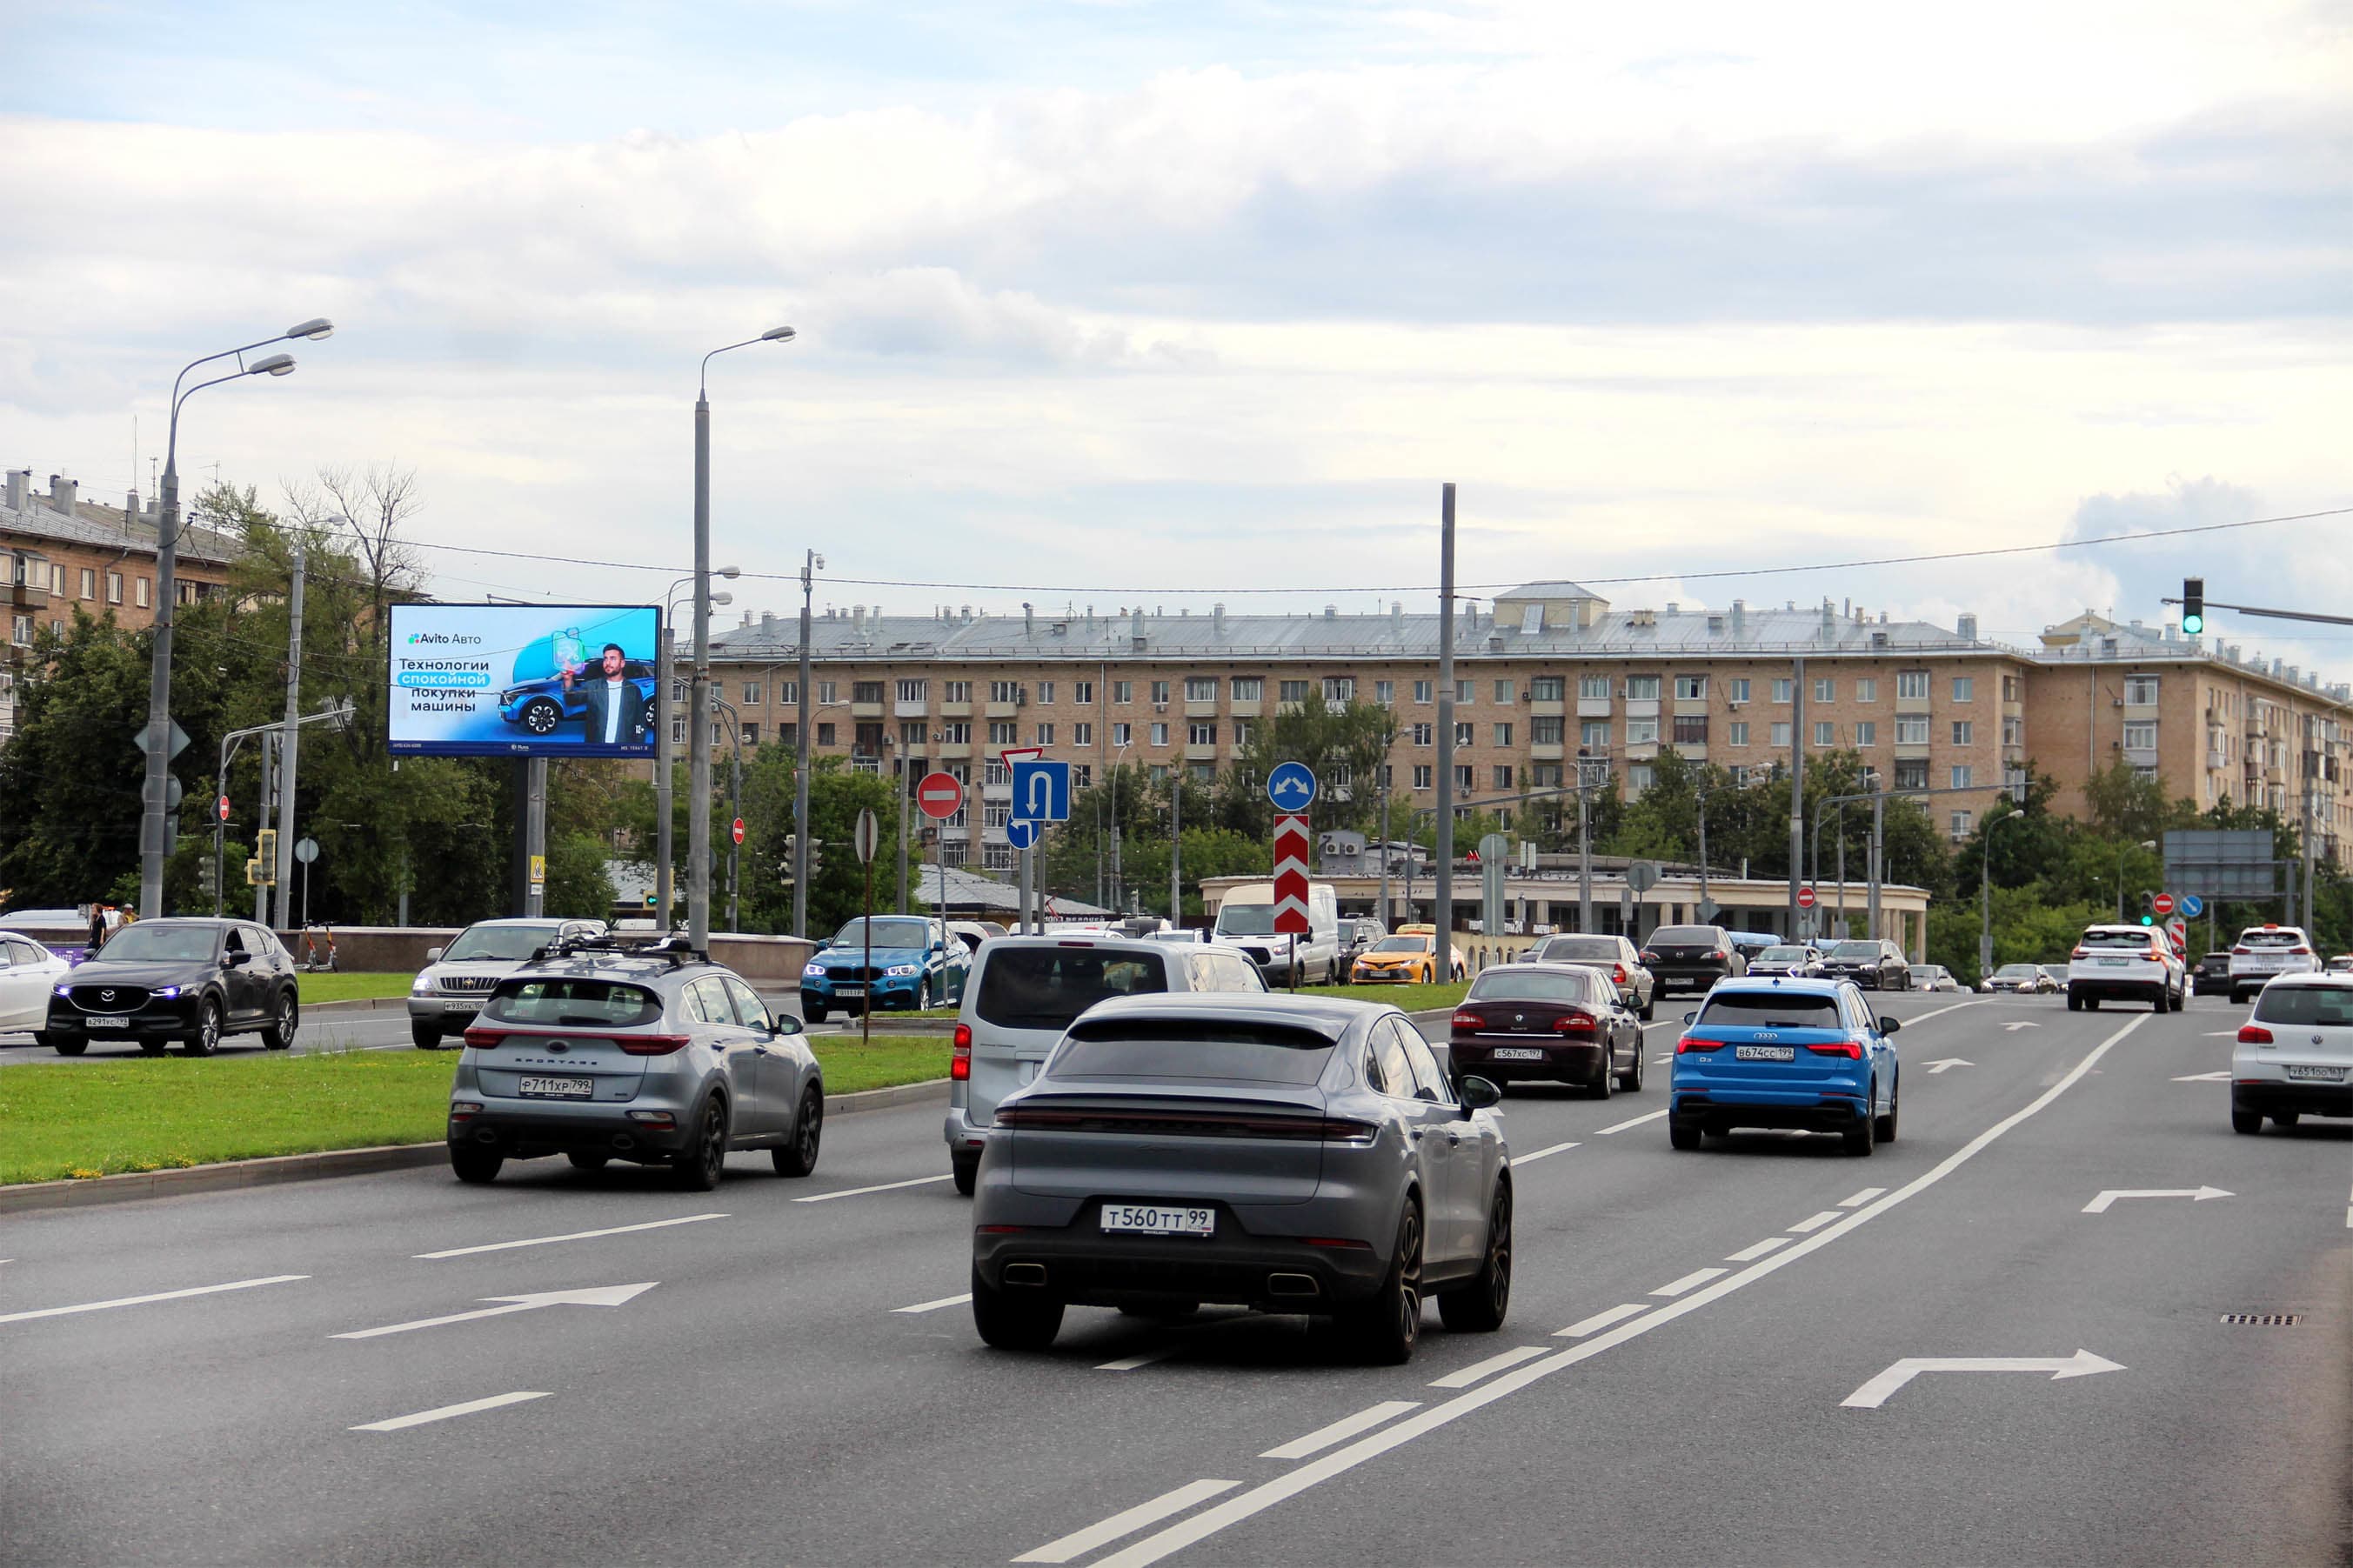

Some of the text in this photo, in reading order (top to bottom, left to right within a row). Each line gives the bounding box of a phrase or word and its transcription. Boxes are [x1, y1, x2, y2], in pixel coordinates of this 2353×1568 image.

[420, 633, 482, 644] Avito Авто
[398, 657, 490, 671] Технологии
[401, 671, 486, 684] спокойной
[411, 688, 476, 701] покупки
[411, 702, 476, 712] машины
[1496, 1049, 1527, 1058] С567ХС
[1740, 1047, 1775, 1058] В674СС
[524, 1078, 590, 1091] Р711ХР 799
[1109, 1207, 1208, 1229] Т560ТТ 99
